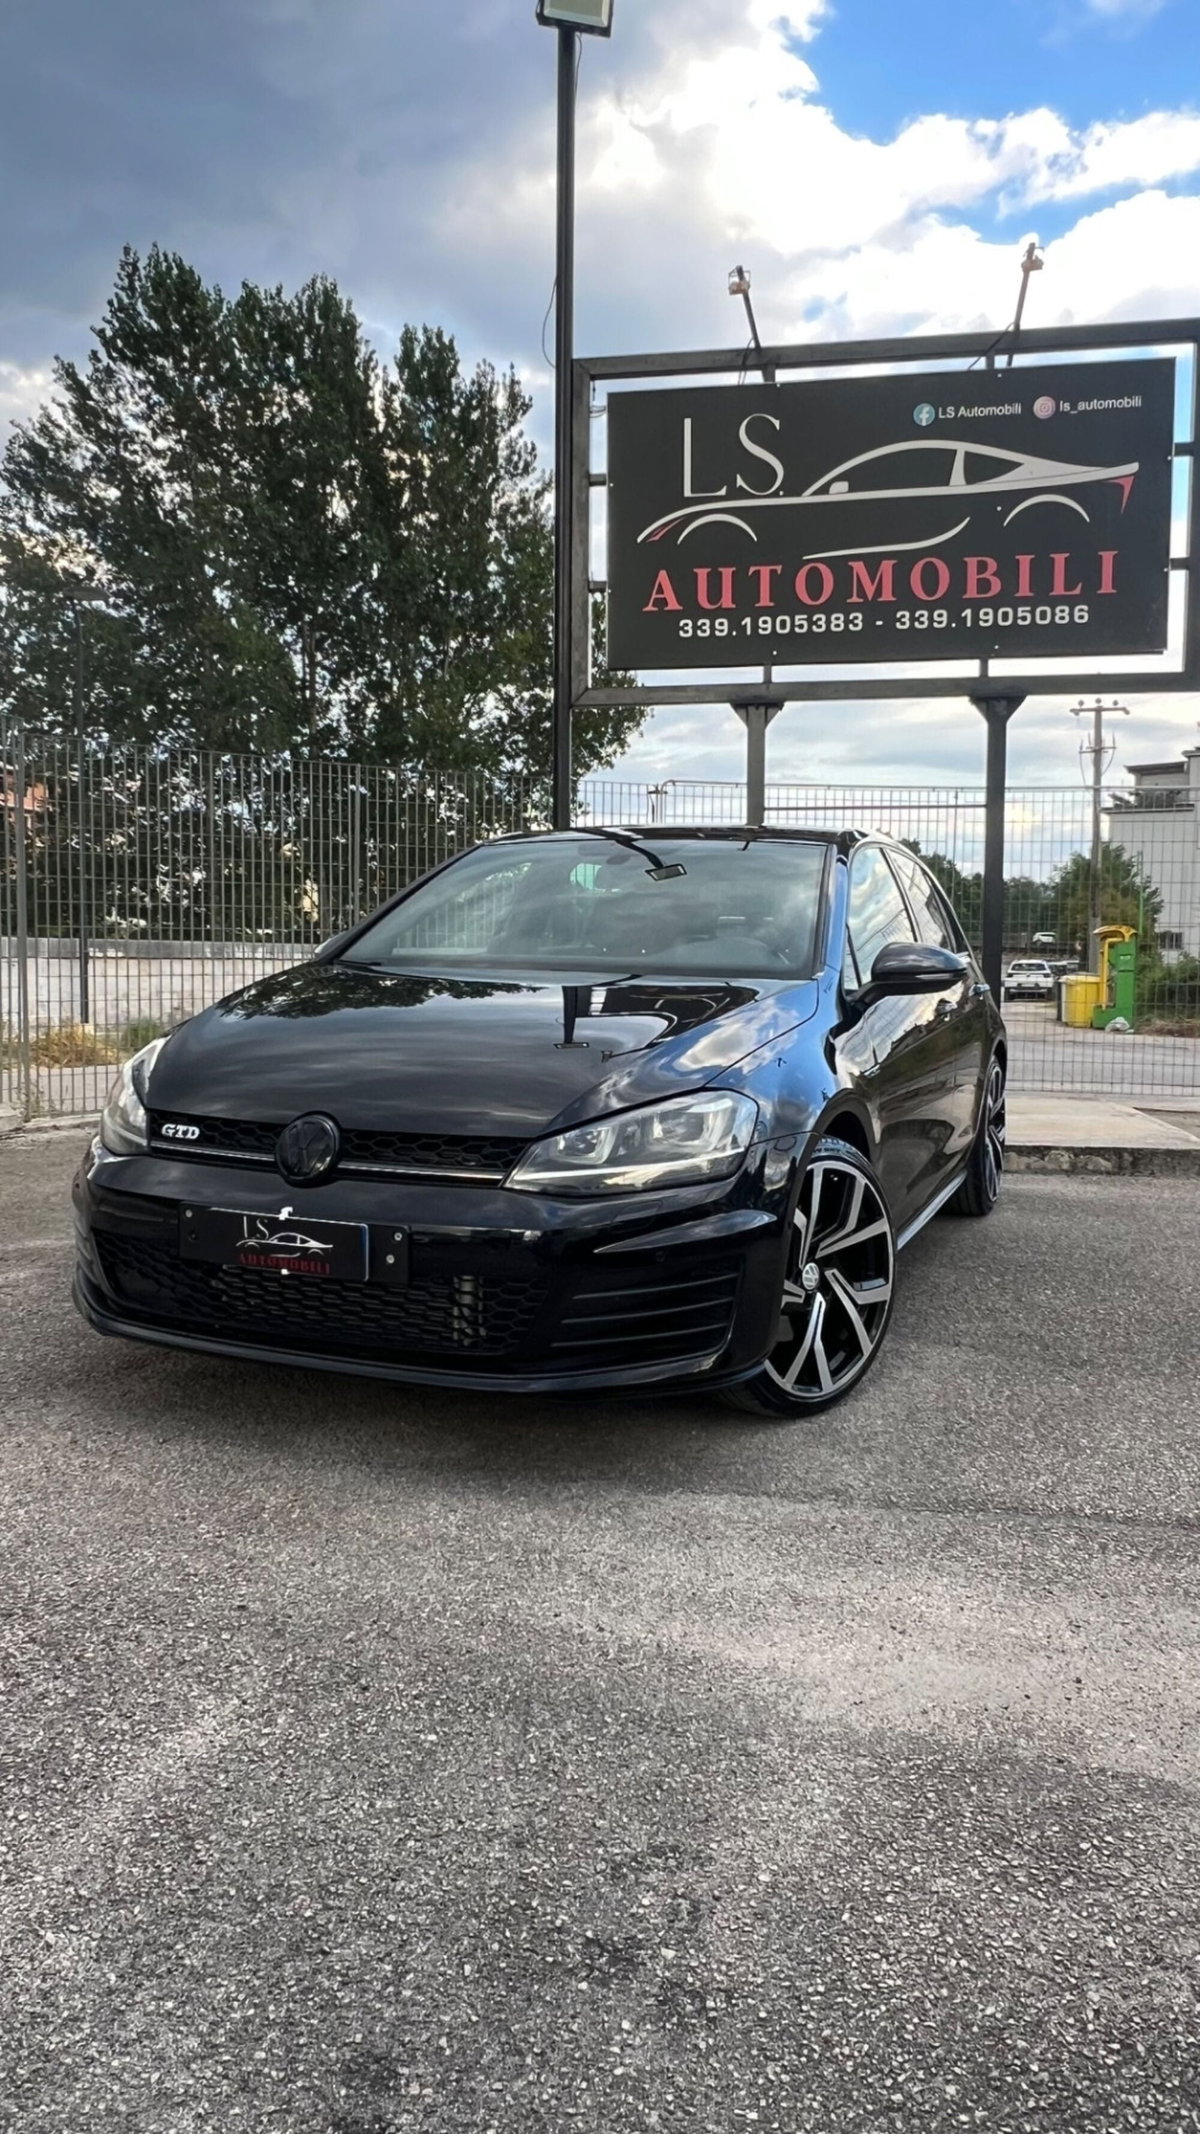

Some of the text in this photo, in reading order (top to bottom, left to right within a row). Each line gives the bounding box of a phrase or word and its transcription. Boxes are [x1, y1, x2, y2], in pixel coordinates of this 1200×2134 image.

[938, 403, 1022, 419] LS Automobili
[1059, 395, 1142, 414] ls_automobili
[642, 551, 1118, 611] AUTOMOBILI
[678, 612, 864, 638] 339.1905383
[895, 604, 1090, 630] 339.1905086
[161, 1123, 200, 1140] GTD
